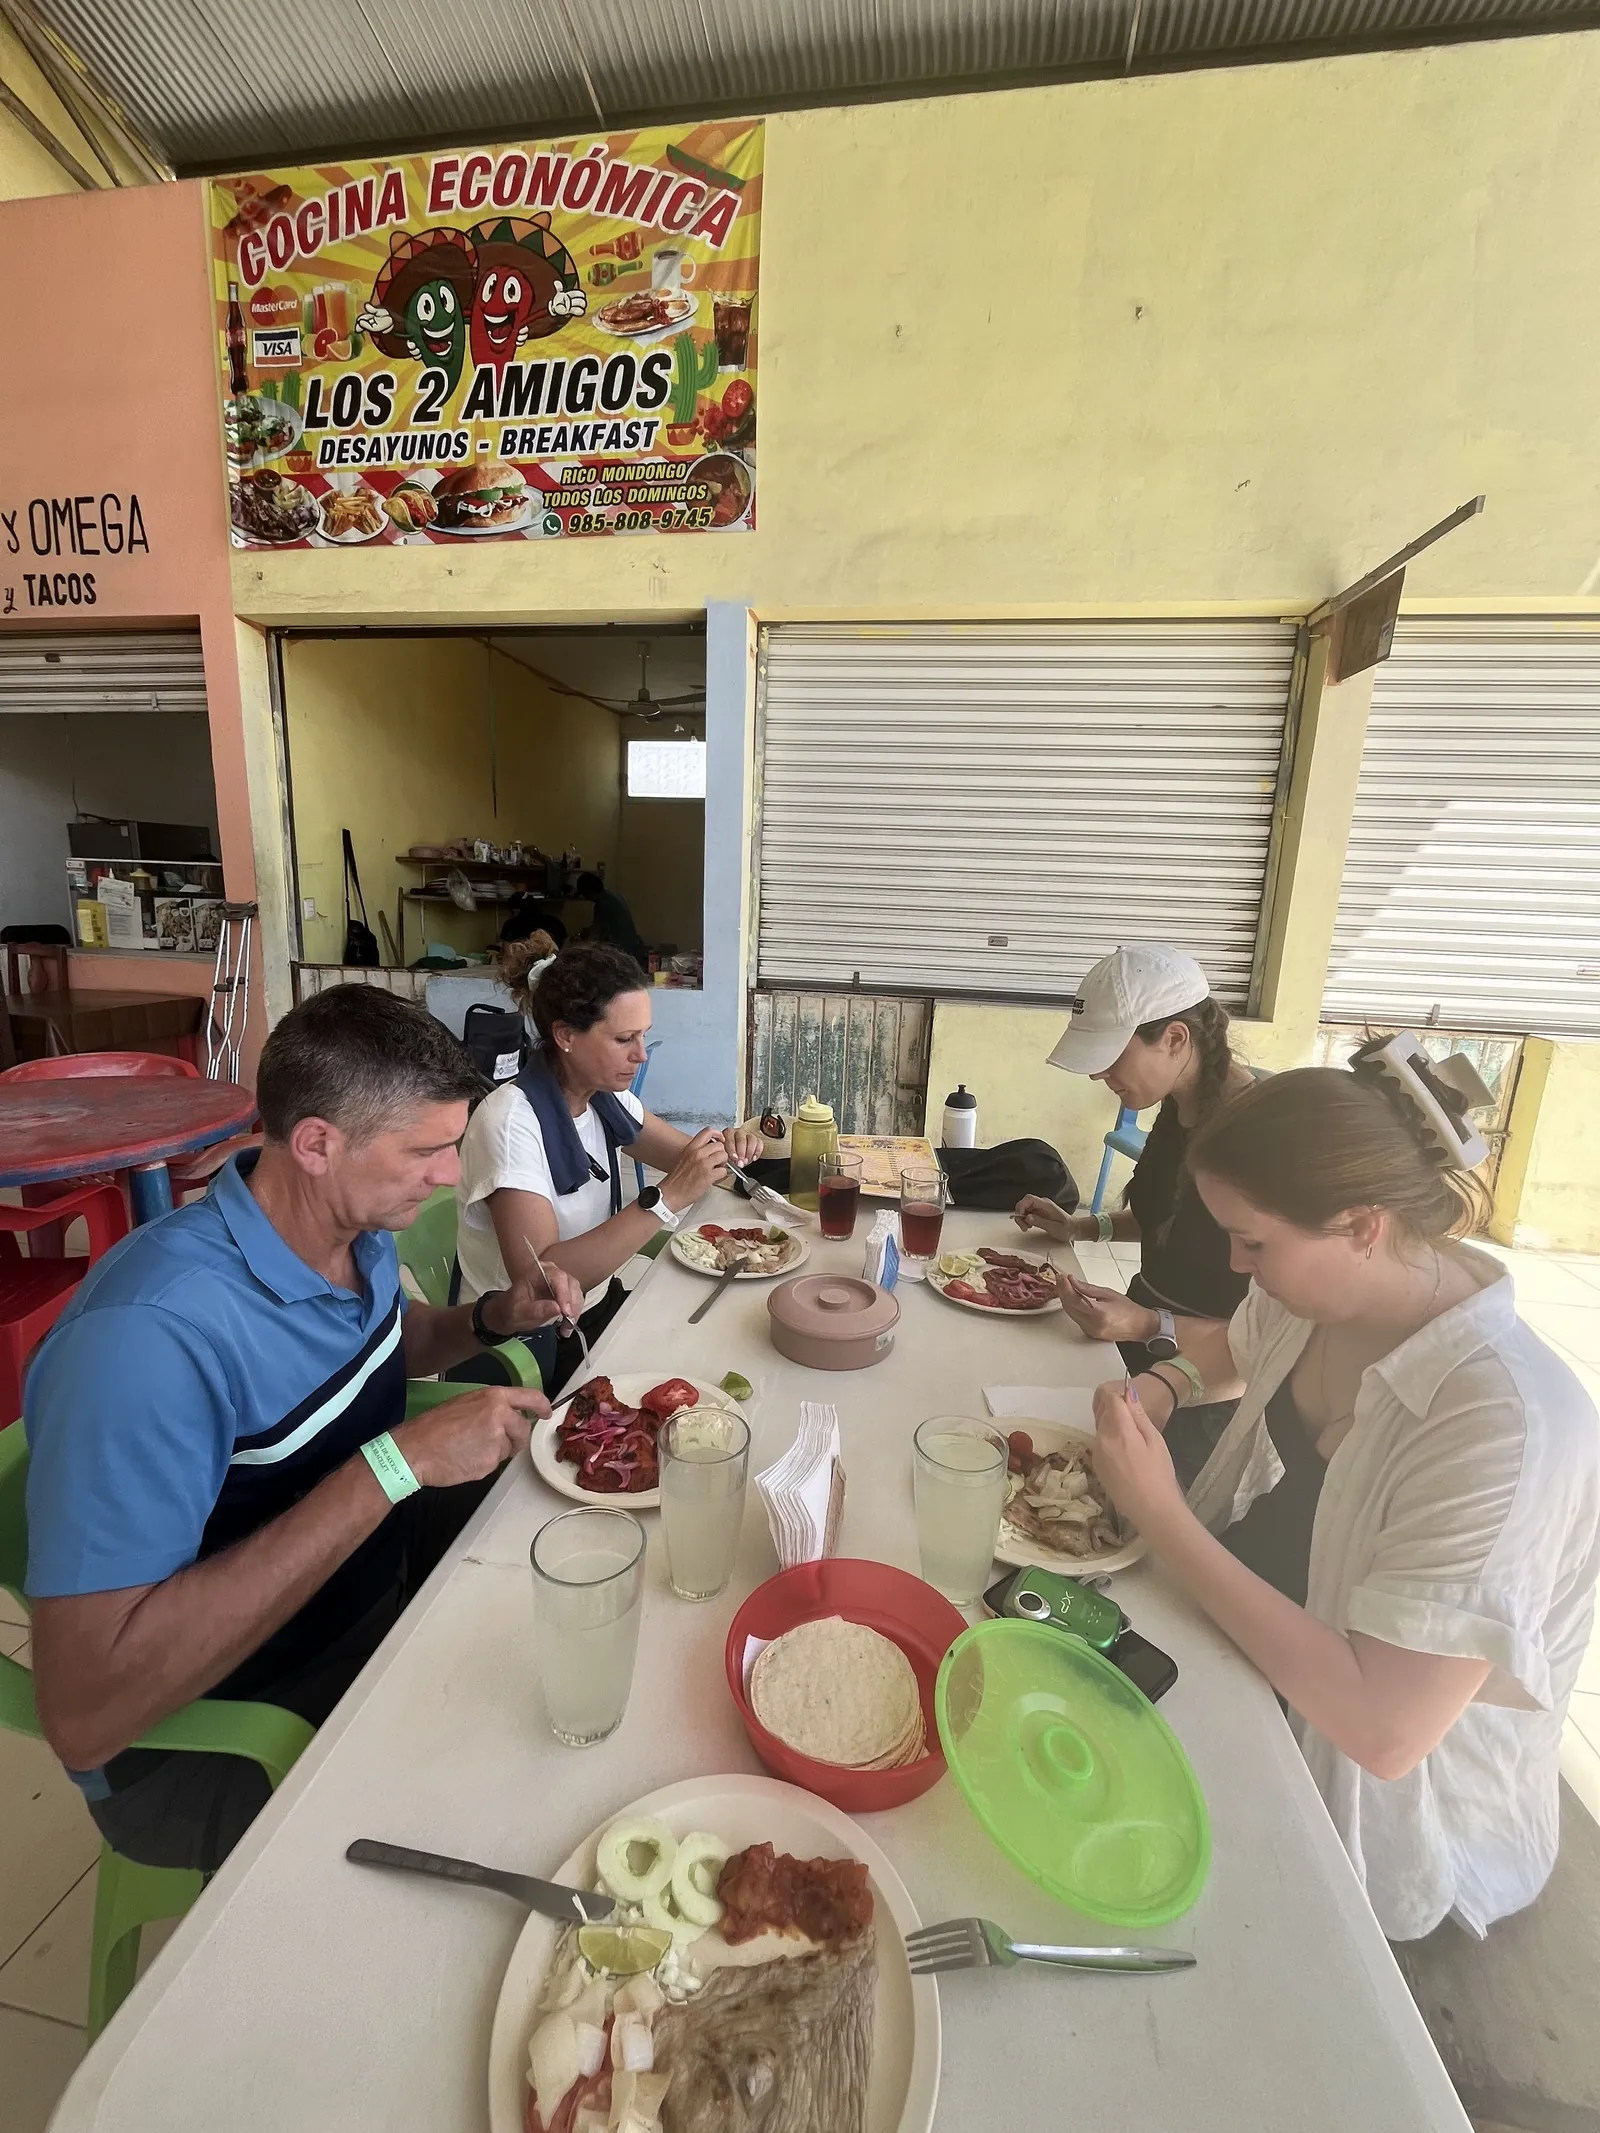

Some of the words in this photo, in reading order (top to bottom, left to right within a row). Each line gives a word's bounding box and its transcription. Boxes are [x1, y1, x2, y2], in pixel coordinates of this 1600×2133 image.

[239, 171, 407, 287] COCINA
[428, 147, 739, 248] ECONÓMICA
[251, 300, 298, 313] MasterCard
[262, 341, 292, 356] VISA
[304, 373, 395, 429] LOS
[412, 369, 448, 423] 2
[462, 352, 672, 421] AMIGOS
[319, 432, 469, 464] DESAYUNOS
[499, 421, 660, 456] BREAKFAST
[562, 466, 597, 485] RICO
[601, 463, 687, 483] MONDONGO
[543, 490, 590, 508] TODOS
[594, 488, 622, 505] LOS
[627, 484, 708, 503] DOMINGOS
[28, 493, 150, 556] OMEGA
[568, 507, 713, 533] 985-808-9745
[22, 572, 97, 606] TACOS
